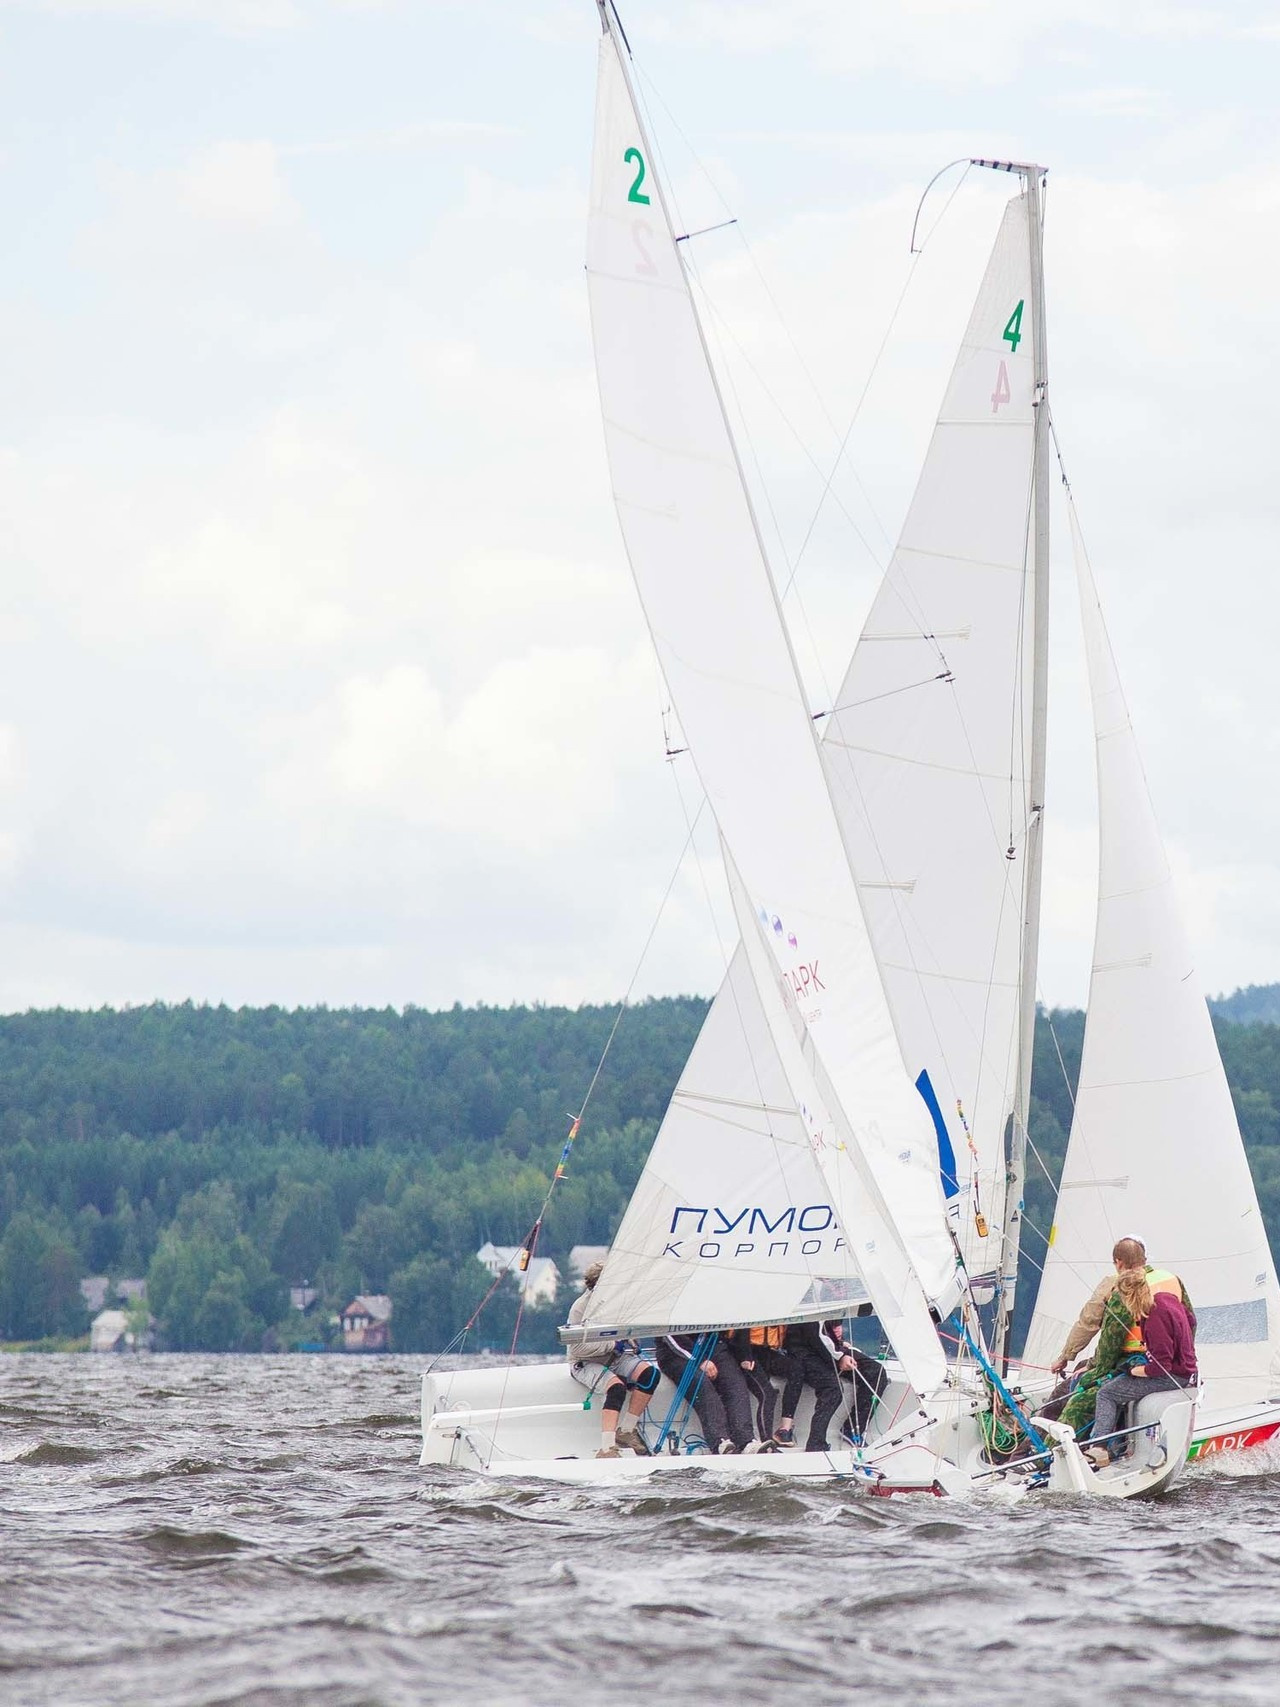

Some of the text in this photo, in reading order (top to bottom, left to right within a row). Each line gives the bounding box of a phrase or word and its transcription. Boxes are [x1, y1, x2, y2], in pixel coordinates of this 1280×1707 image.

[624, 147, 650, 205] 2
[1003, 299, 1024, 352] 4
[670, 1205, 838, 1234] ПУМО
